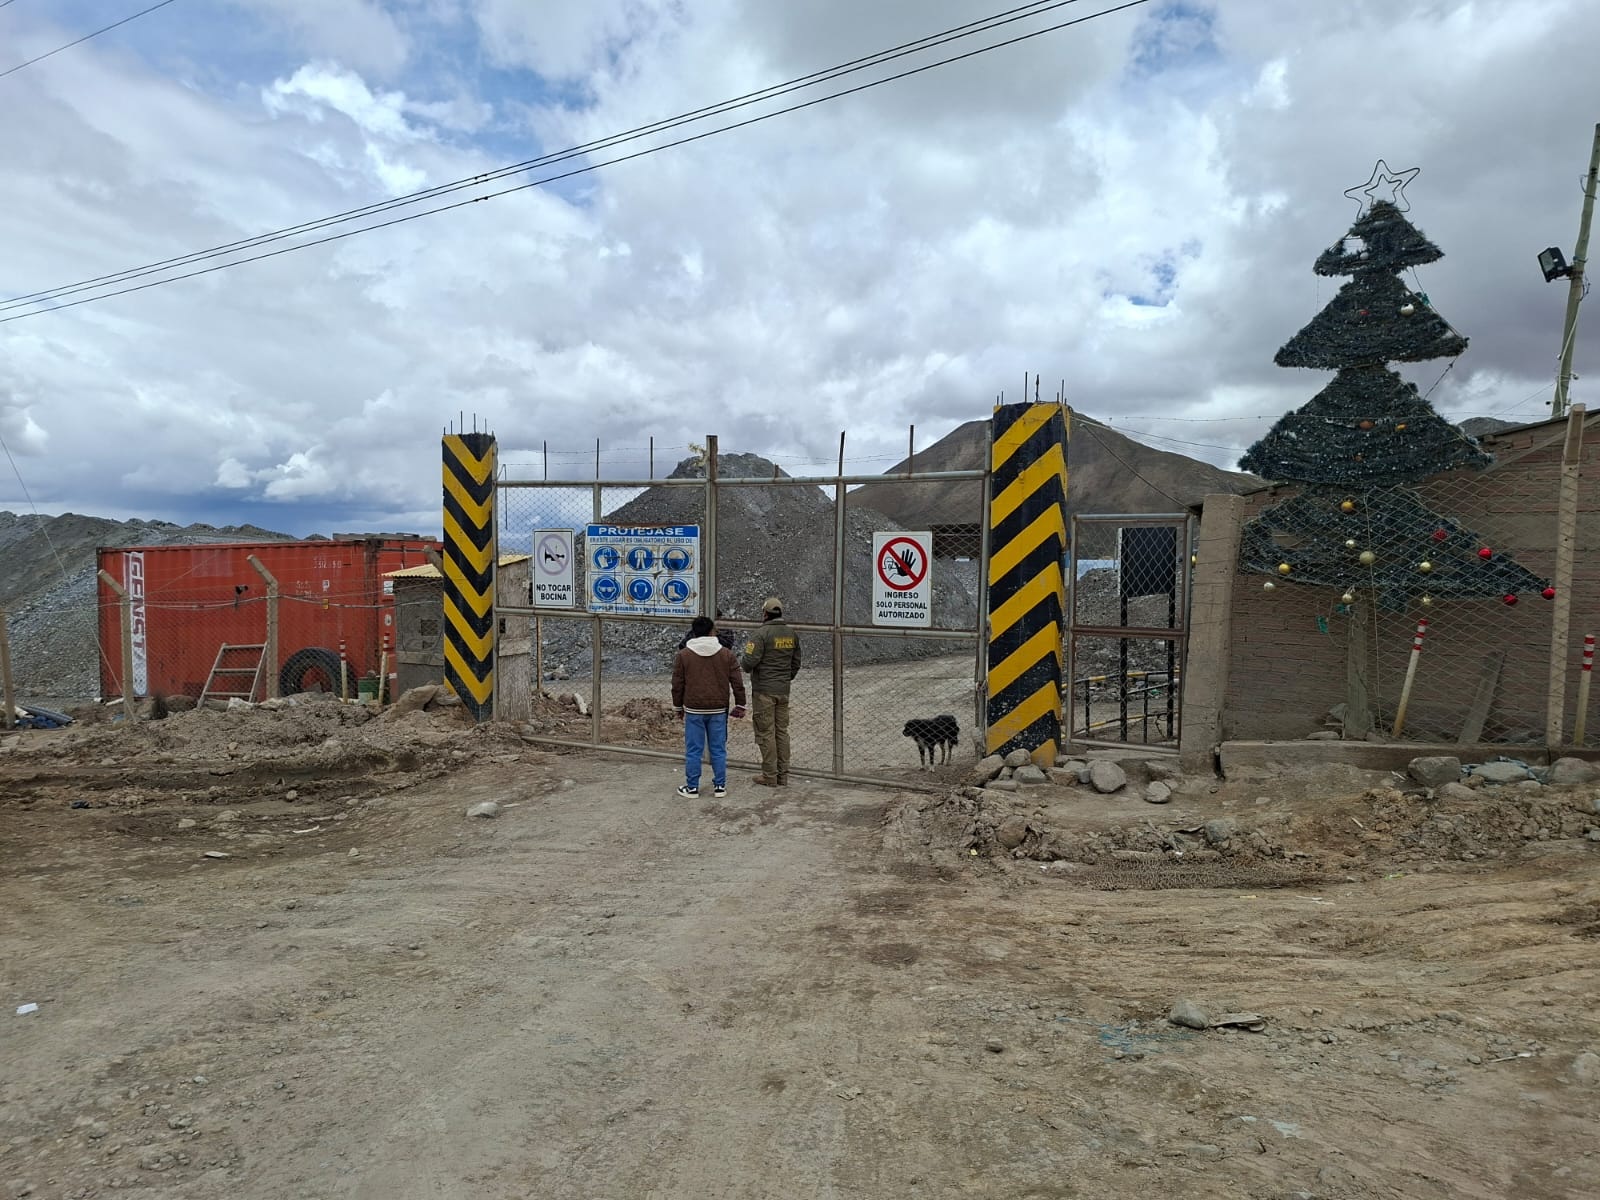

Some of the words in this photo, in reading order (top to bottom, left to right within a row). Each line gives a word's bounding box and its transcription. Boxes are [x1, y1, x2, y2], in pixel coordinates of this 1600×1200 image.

[598, 527, 684, 536] PROTEJASE
[536, 583, 546, 591] NO
[548, 584, 572, 592] TOCAR
[541, 592, 567, 600] BOCINA
[884, 591, 919, 599] INGRESO
[893, 601, 927, 609] PERSONAL
[878, 611, 925, 619] AUTORIZADO
